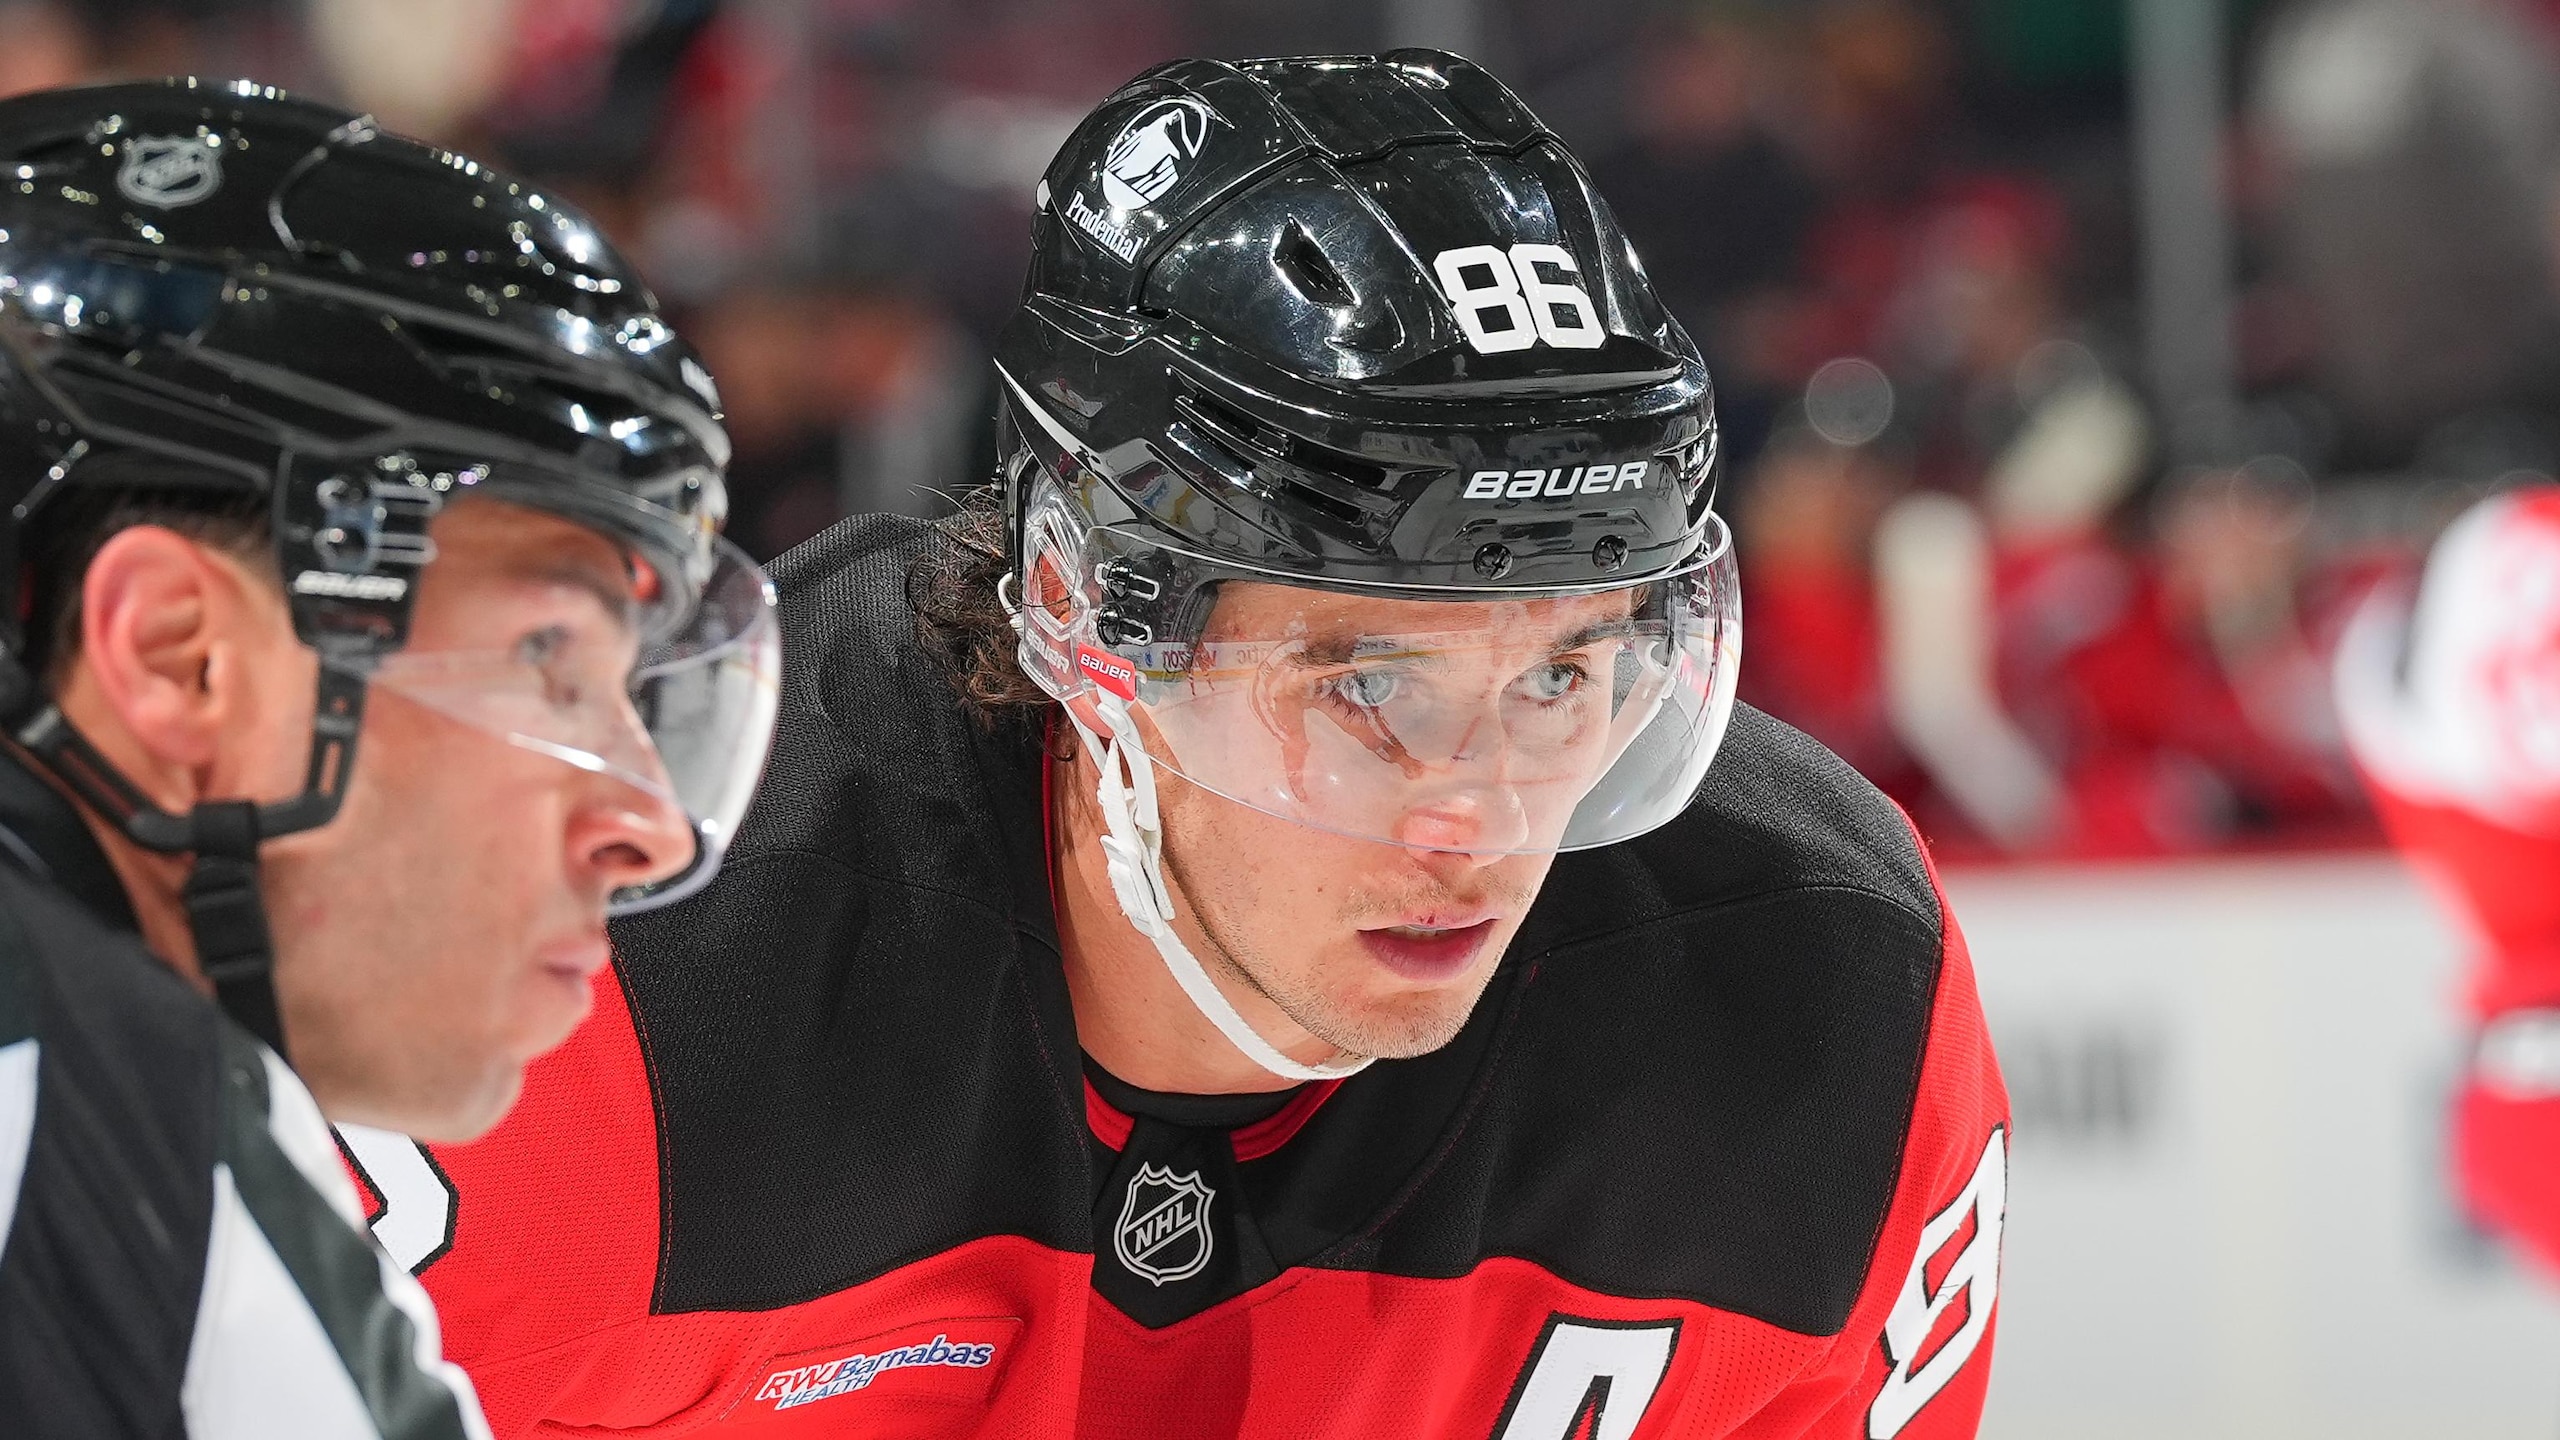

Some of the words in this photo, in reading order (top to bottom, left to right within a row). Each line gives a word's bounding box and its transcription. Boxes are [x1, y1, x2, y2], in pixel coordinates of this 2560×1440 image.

[1065, 190, 1144, 264] Prudential
[1432, 243, 1606, 354] 86
[1462, 460, 1649, 500] BAUER
[1080, 653, 1132, 682] BAUER
[1134, 1200, 1193, 1255] NHL
[778, 1372, 874, 1409] HEALTH
[1490, 1310, 1684, 1440] A
